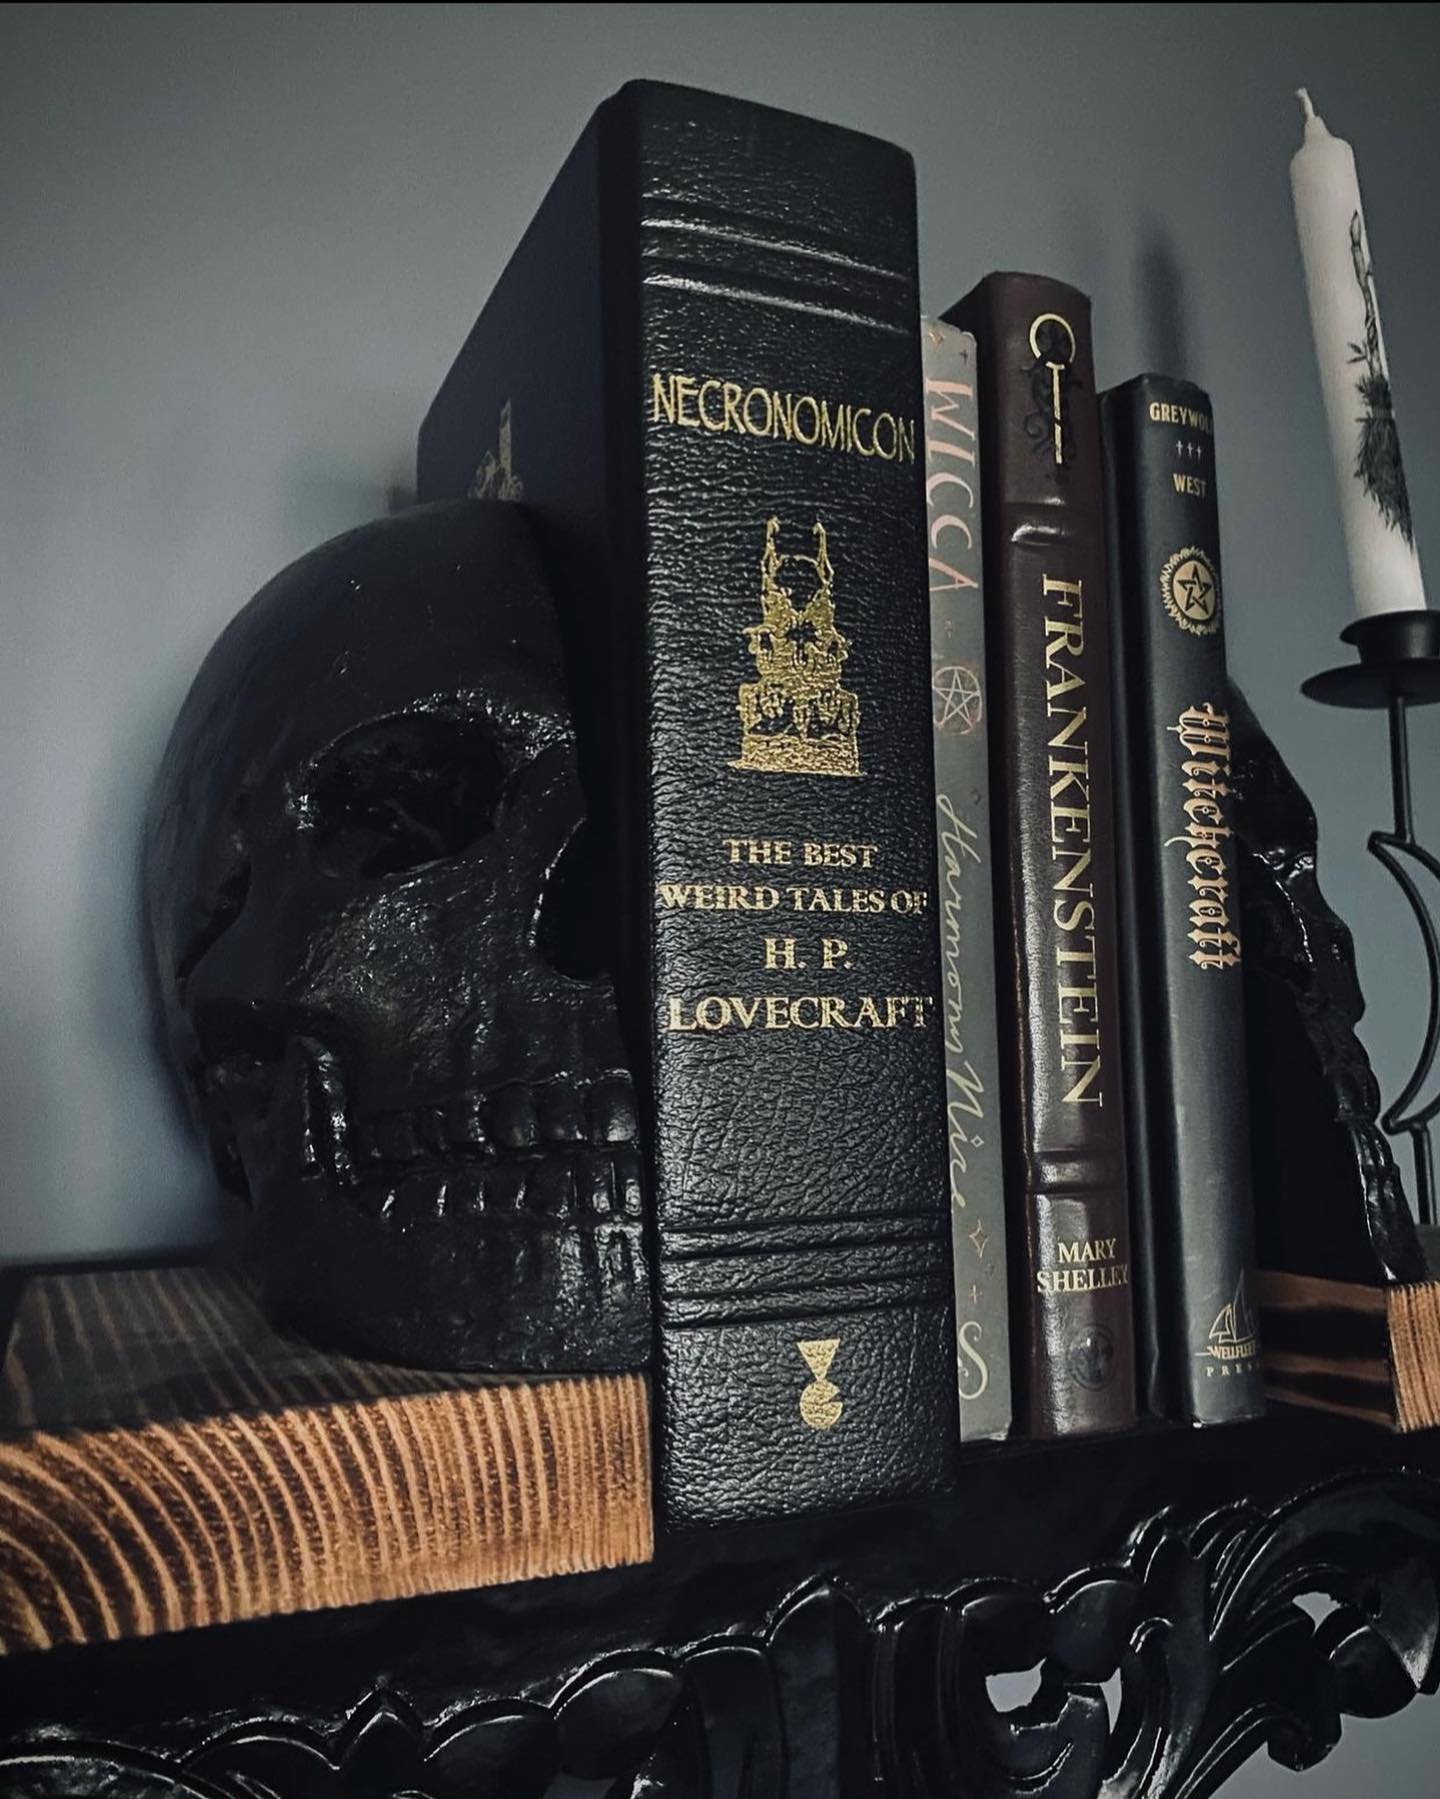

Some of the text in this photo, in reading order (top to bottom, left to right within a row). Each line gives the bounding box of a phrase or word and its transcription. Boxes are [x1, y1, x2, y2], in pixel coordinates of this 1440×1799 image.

[653, 373, 914, 464] NECRONOMICON
[925, 378, 979, 592] WICCA
[1173, 473, 1206, 499] WEST
[723, 838, 878, 868] THE BEST
[1042, 573, 1102, 1107] FRANKENSTEIN
[1164, 702, 1241, 970] Witchcraft
[657, 884, 928, 915] WEIRD TALES OF
[764, 936, 853, 970] H. P.
[667, 996, 934, 1032] LOVECRAFT
[937, 794, 985, 1208] Harmony Nice
[1057, 1238, 1116, 1263] MARY
[1036, 1264, 1128, 1293] SHELLEY
